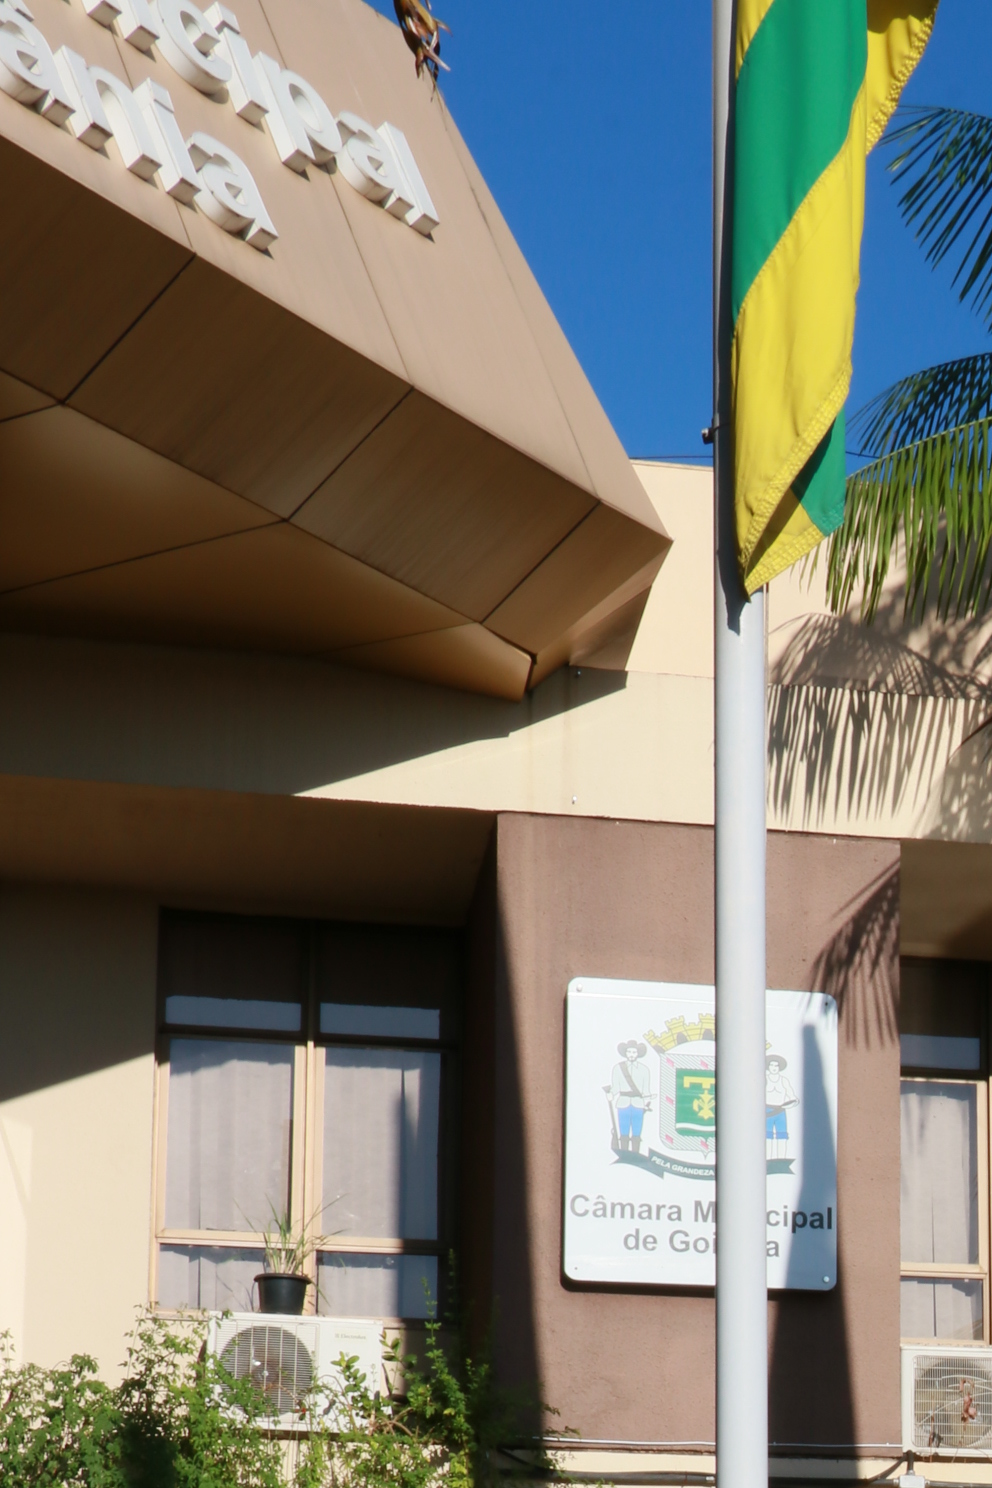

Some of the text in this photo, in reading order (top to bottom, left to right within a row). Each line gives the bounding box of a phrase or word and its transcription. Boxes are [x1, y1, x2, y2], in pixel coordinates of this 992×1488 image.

[651, 1156, 715, 1176] PELA GRANDEZA
[570, 1194, 832, 1234] Câmara Mcipal
[623, 1228, 658, 1252] de
